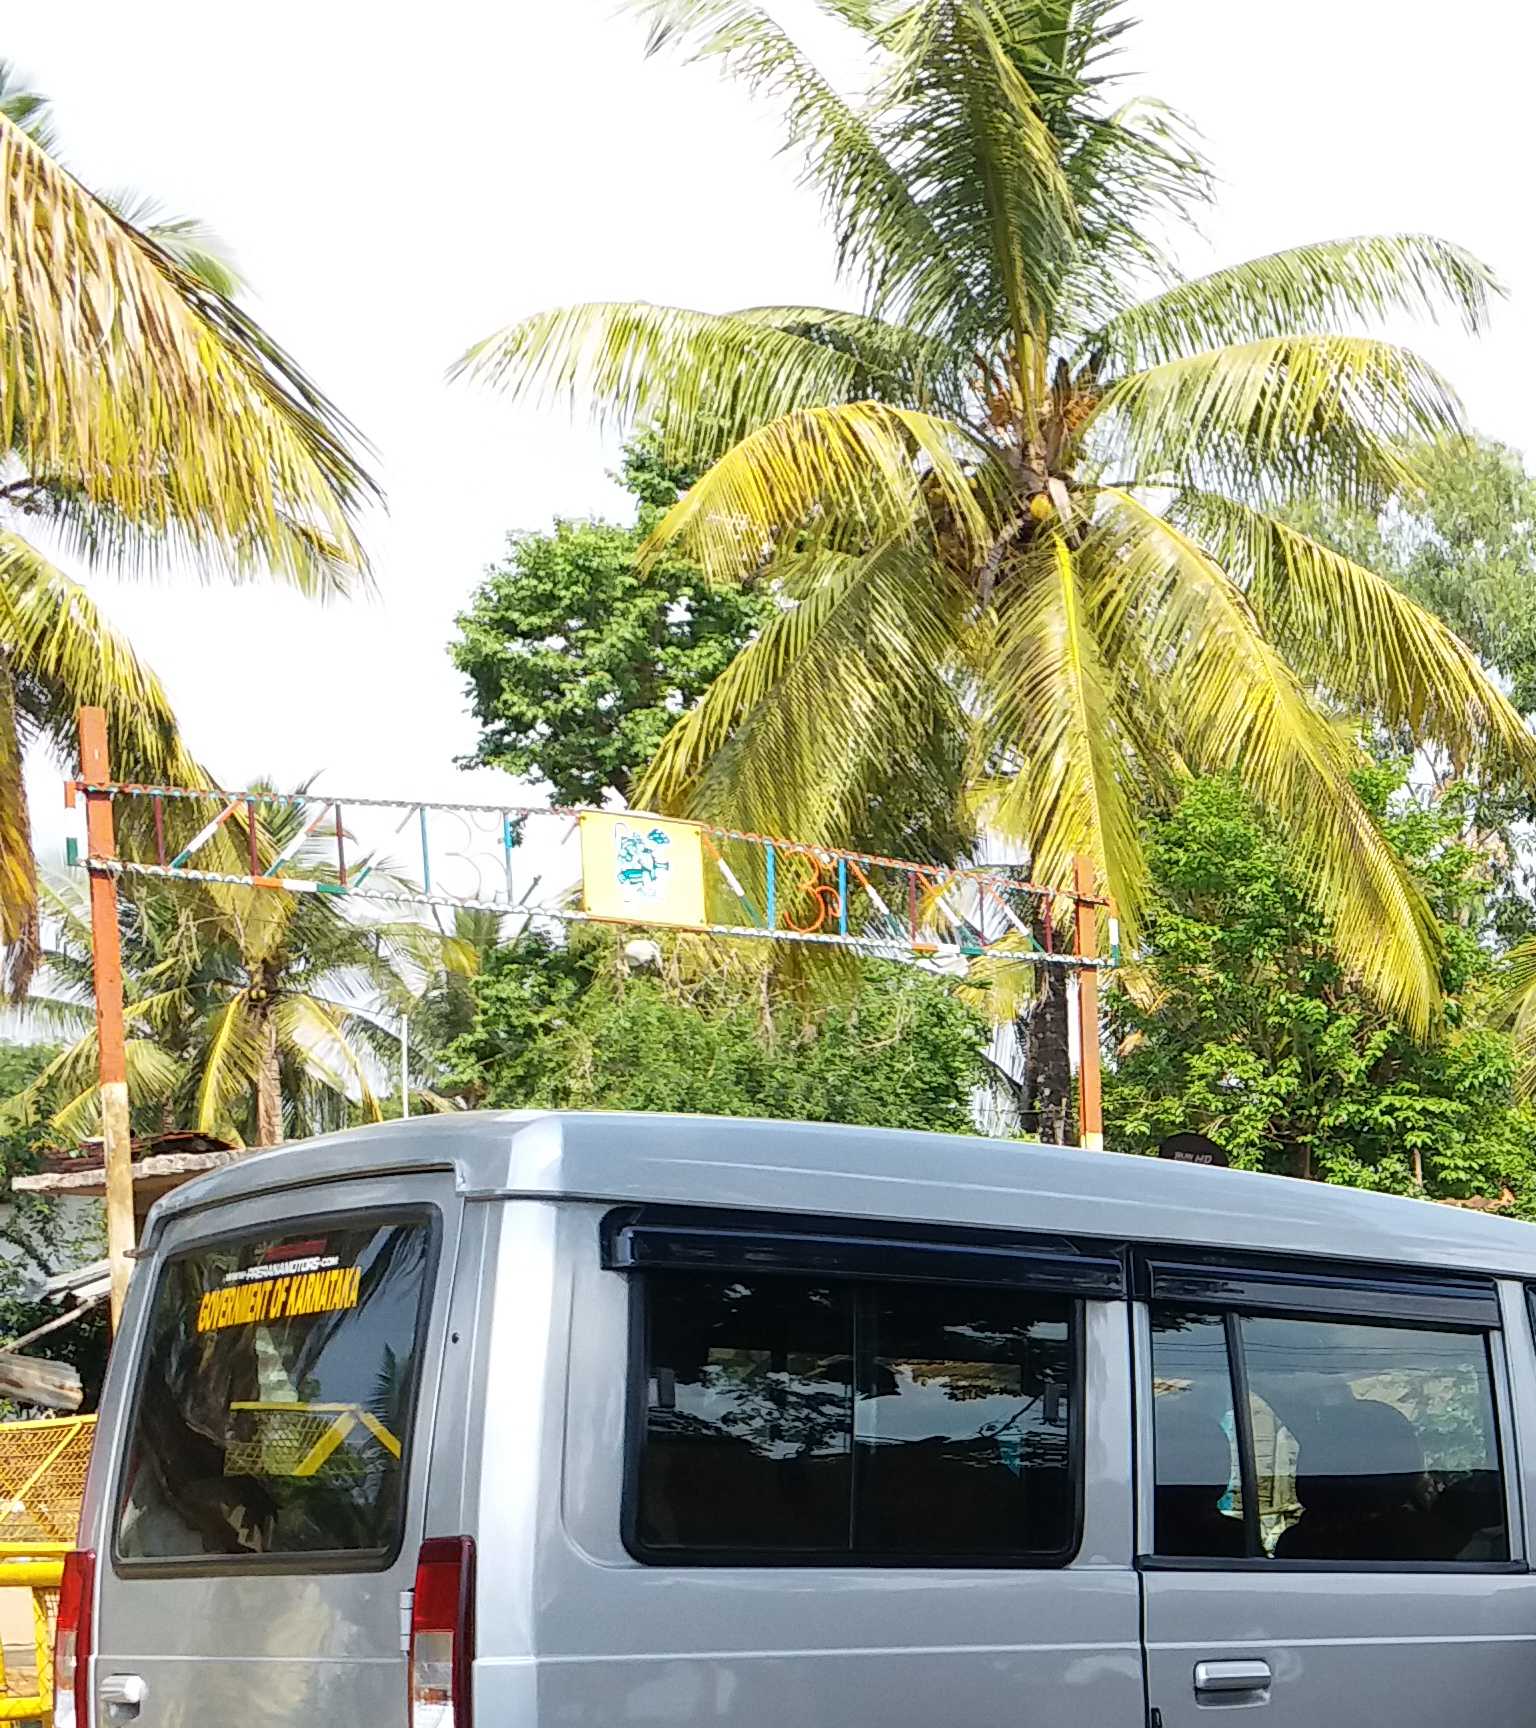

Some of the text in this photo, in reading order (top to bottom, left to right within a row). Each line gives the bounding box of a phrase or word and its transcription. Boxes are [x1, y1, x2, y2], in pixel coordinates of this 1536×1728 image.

[197, 1266, 362, 1333] GOVERNMENT OF KARNATAKA
